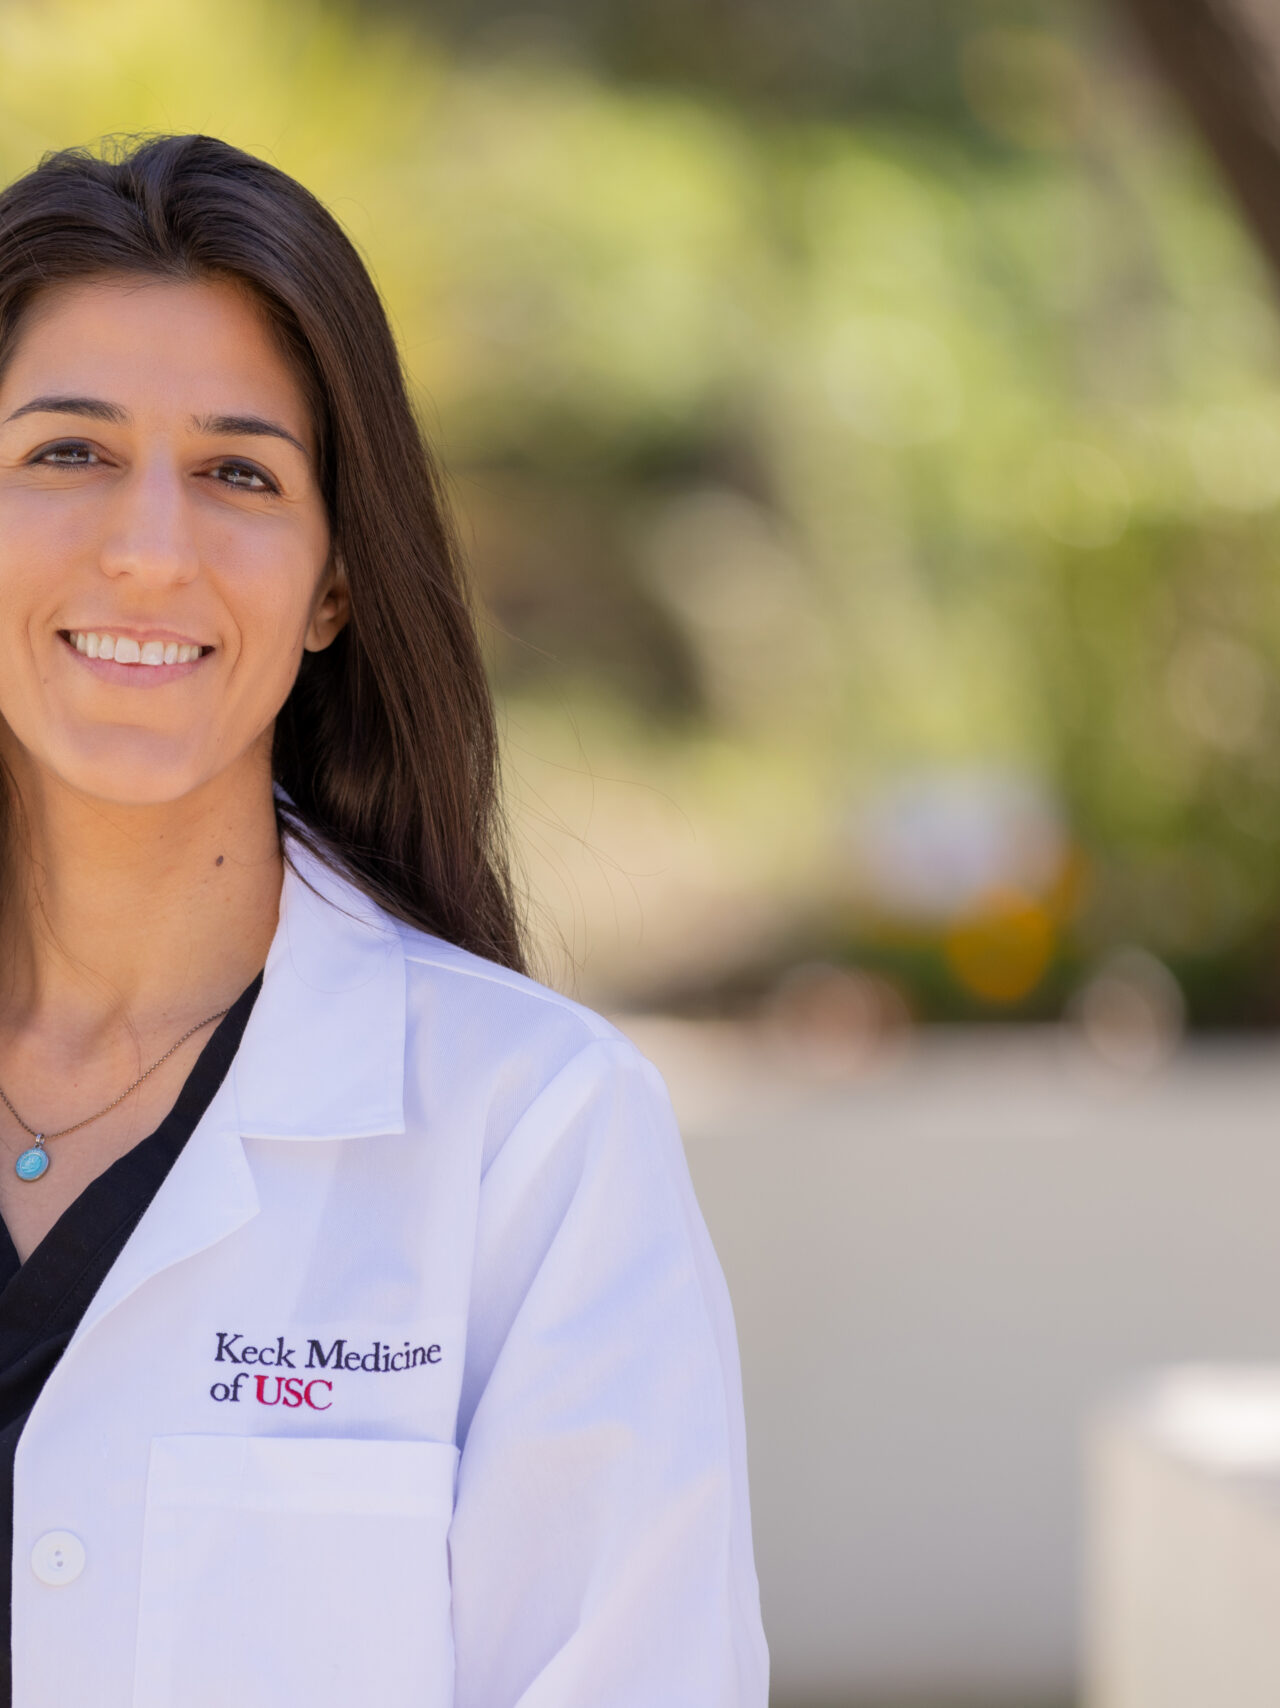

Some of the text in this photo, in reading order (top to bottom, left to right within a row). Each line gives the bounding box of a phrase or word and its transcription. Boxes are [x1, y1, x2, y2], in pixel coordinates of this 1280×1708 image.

[214, 1332, 442, 1372] Keck Medicine
[210, 1372, 333, 1410] of USC
